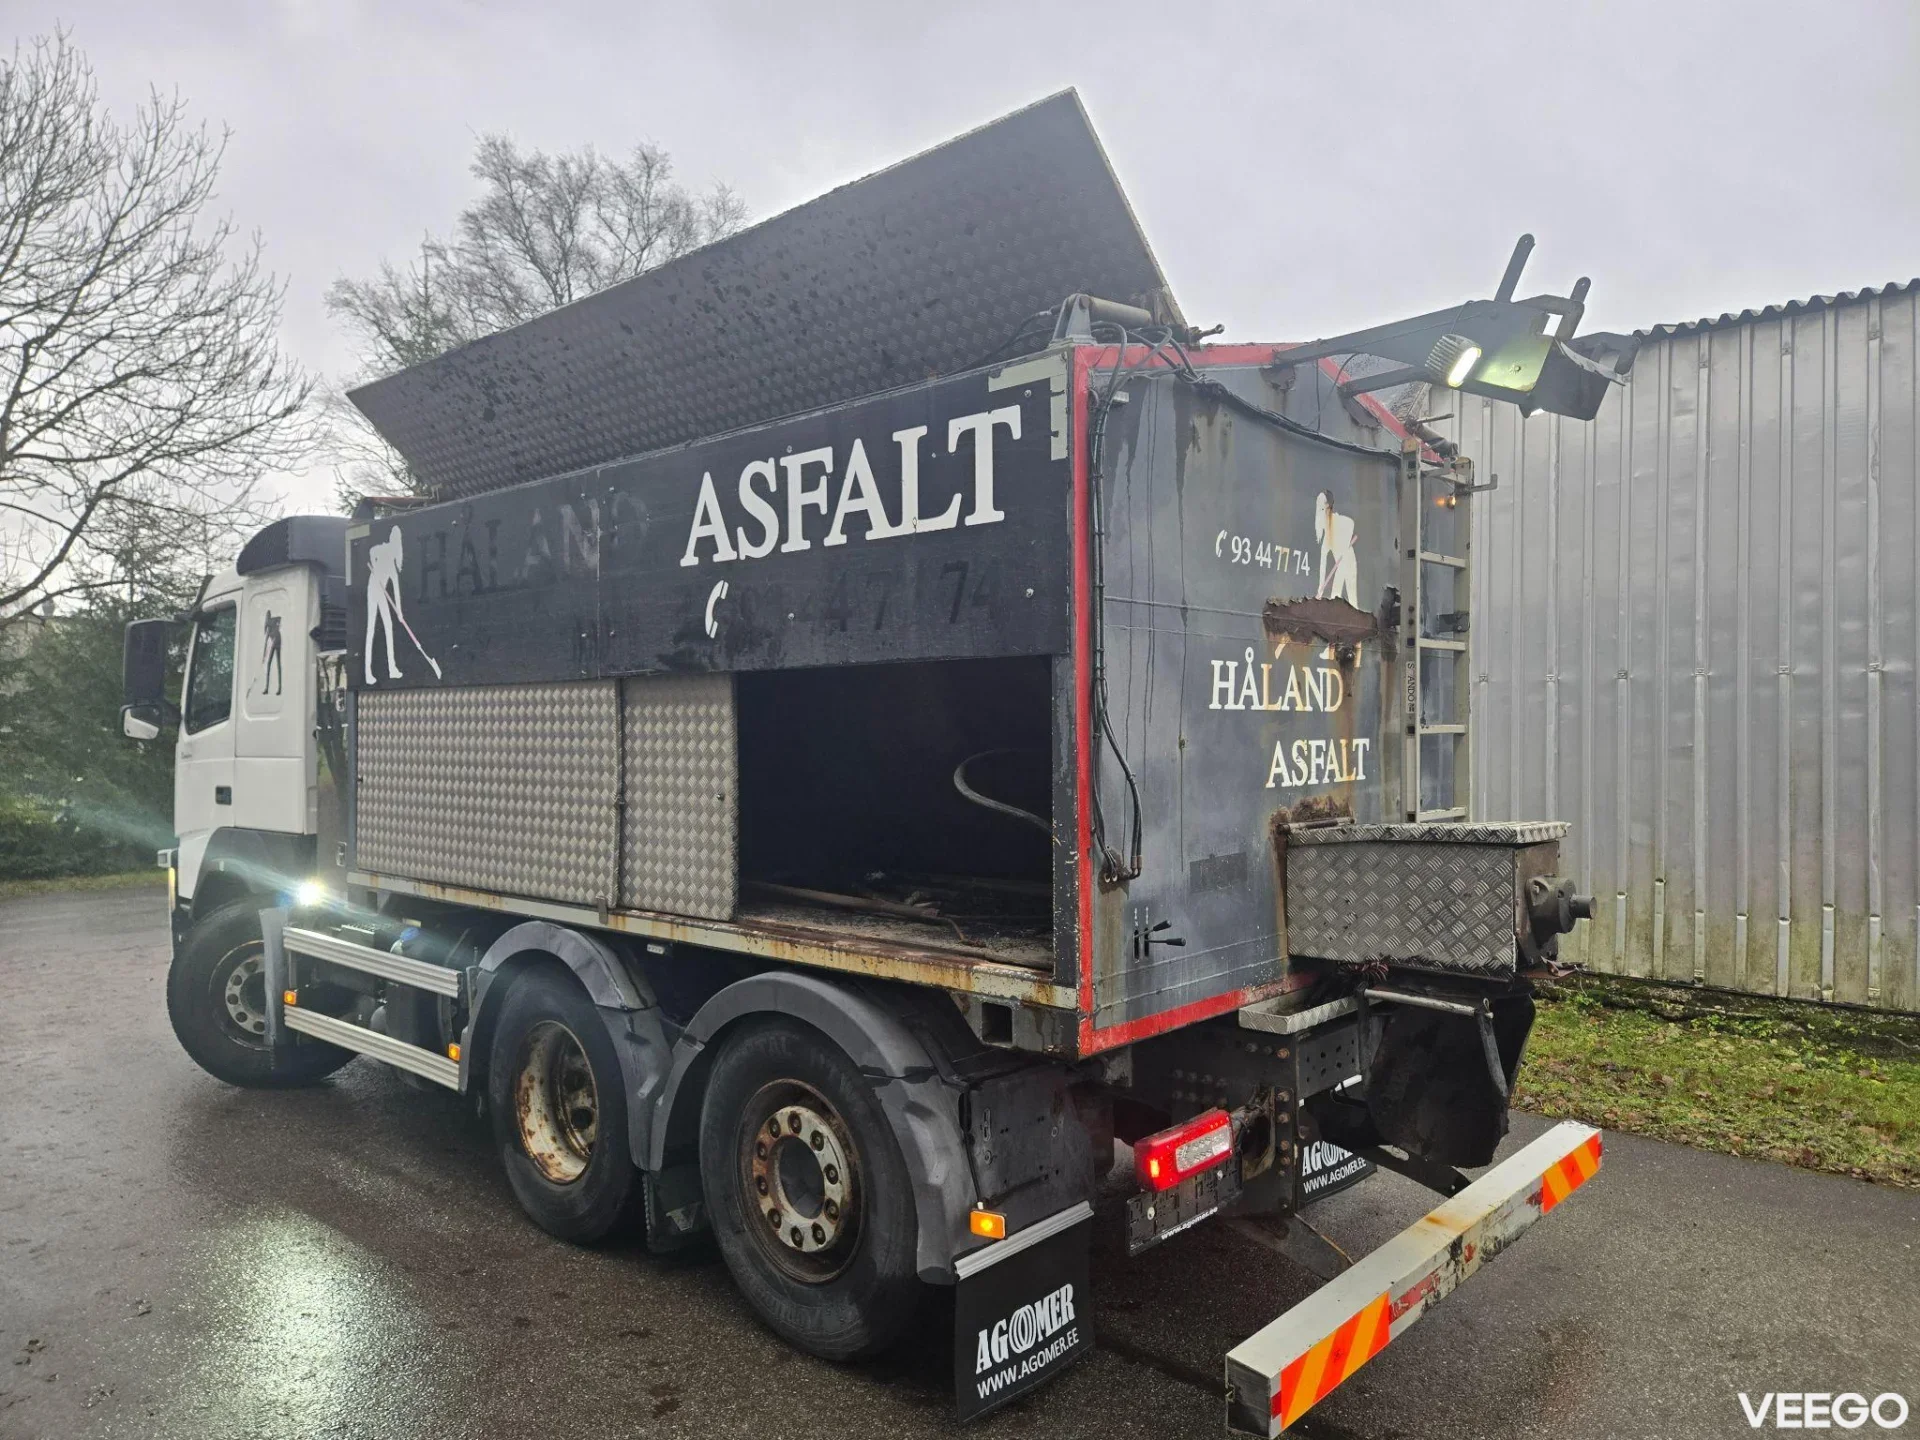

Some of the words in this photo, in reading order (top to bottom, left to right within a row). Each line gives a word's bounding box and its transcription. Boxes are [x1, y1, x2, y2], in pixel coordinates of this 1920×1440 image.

[679, 403, 1022, 568] ASFALT
[1231, 535, 1252, 565] 93
[1254, 540, 1273, 569] 44
[1274, 544, 1290, 573] 77
[1293, 549, 1311, 577] 74
[1208, 646, 1344, 713] HÅLAND
[1407, 662, 1415, 702] SANDO
[1265, 737, 1370, 789] ASFALT
[1303, 1156, 1367, 1195] WWW.AGOMER.EE
[975, 1283, 1076, 1375] AGOMER
[977, 1327, 1080, 1399] WWW.AGOMER.EE
